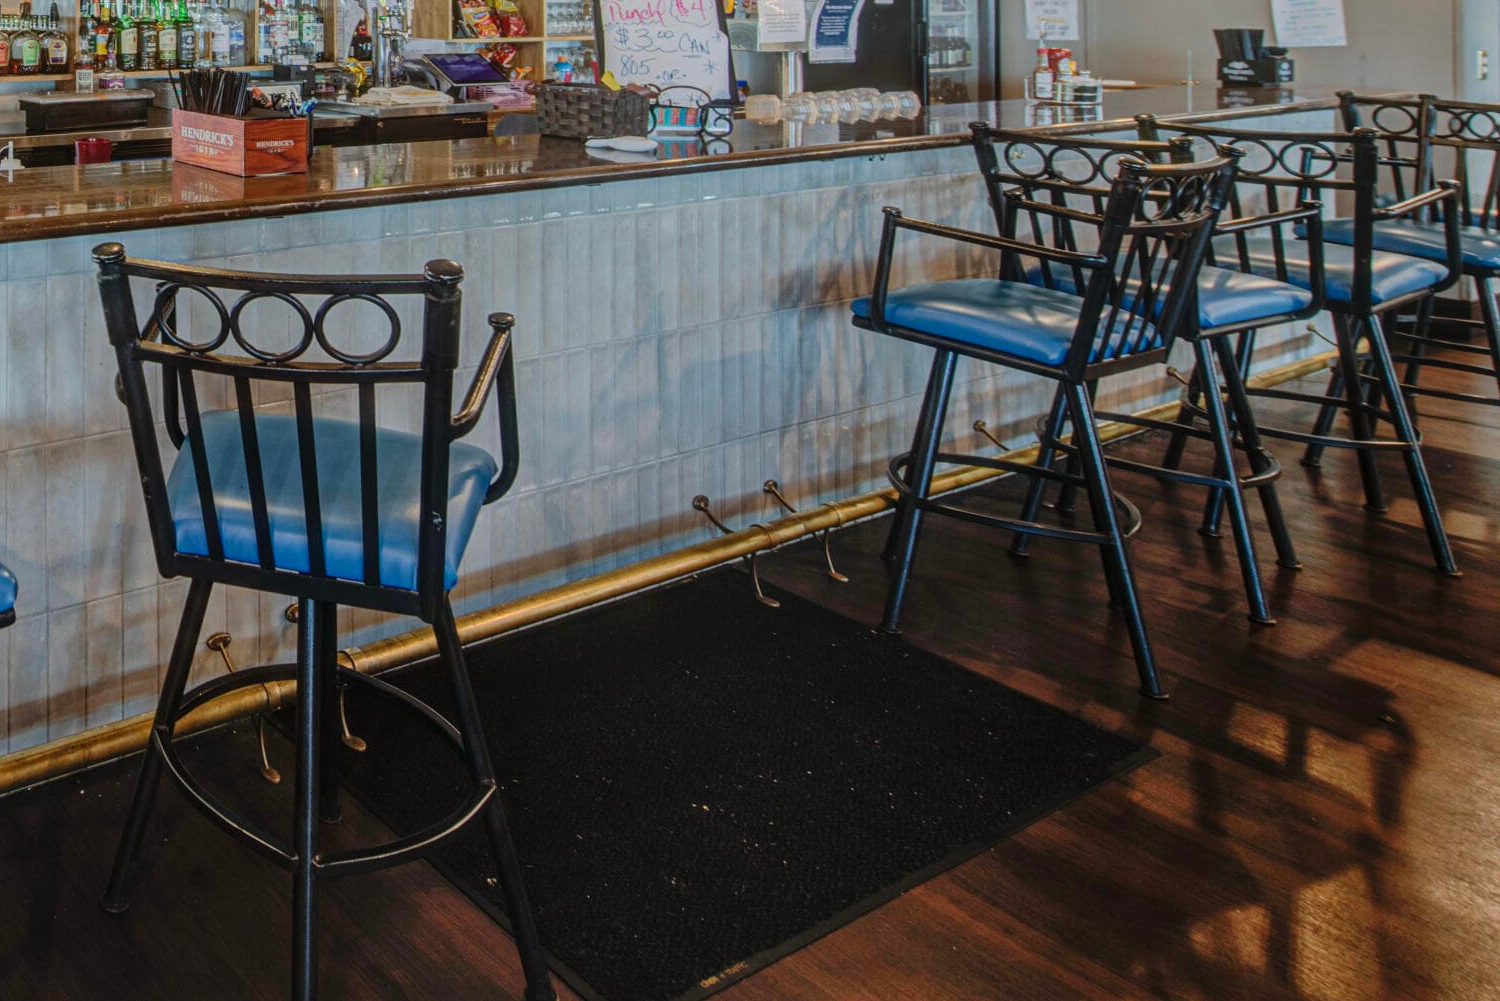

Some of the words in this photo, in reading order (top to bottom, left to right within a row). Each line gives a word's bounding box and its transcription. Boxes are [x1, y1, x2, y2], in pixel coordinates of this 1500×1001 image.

[620, 55, 657, 77] 805
[181, 125, 234, 147] HENDRICK'S
[256, 139, 295, 149] HENDRICK'S
